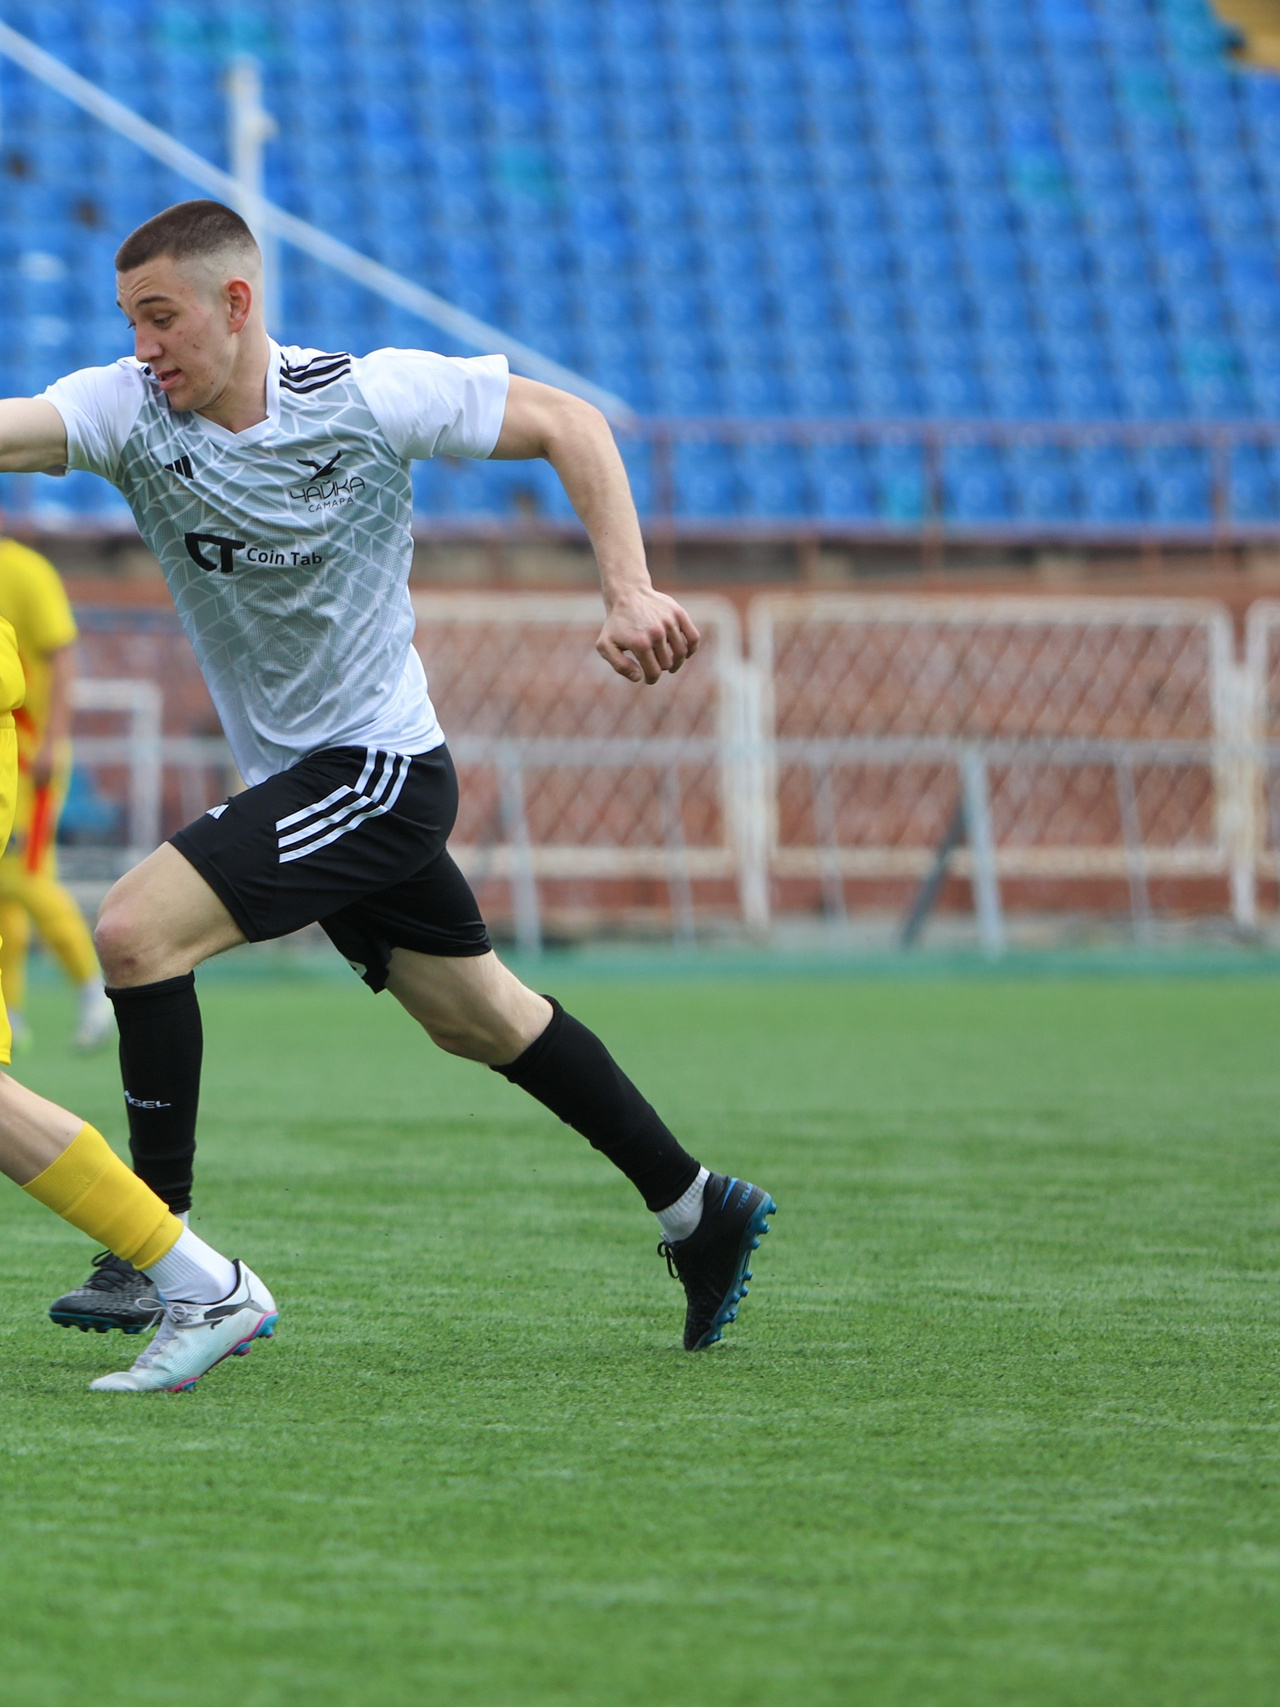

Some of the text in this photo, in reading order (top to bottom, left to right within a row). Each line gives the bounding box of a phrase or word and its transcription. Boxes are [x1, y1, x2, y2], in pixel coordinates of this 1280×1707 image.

[289, 476, 366, 503] ЧАЙКА
[308, 496, 354, 513] САМАРА
[246, 547, 285, 566] Coin
[292, 551, 323, 567] Tab
